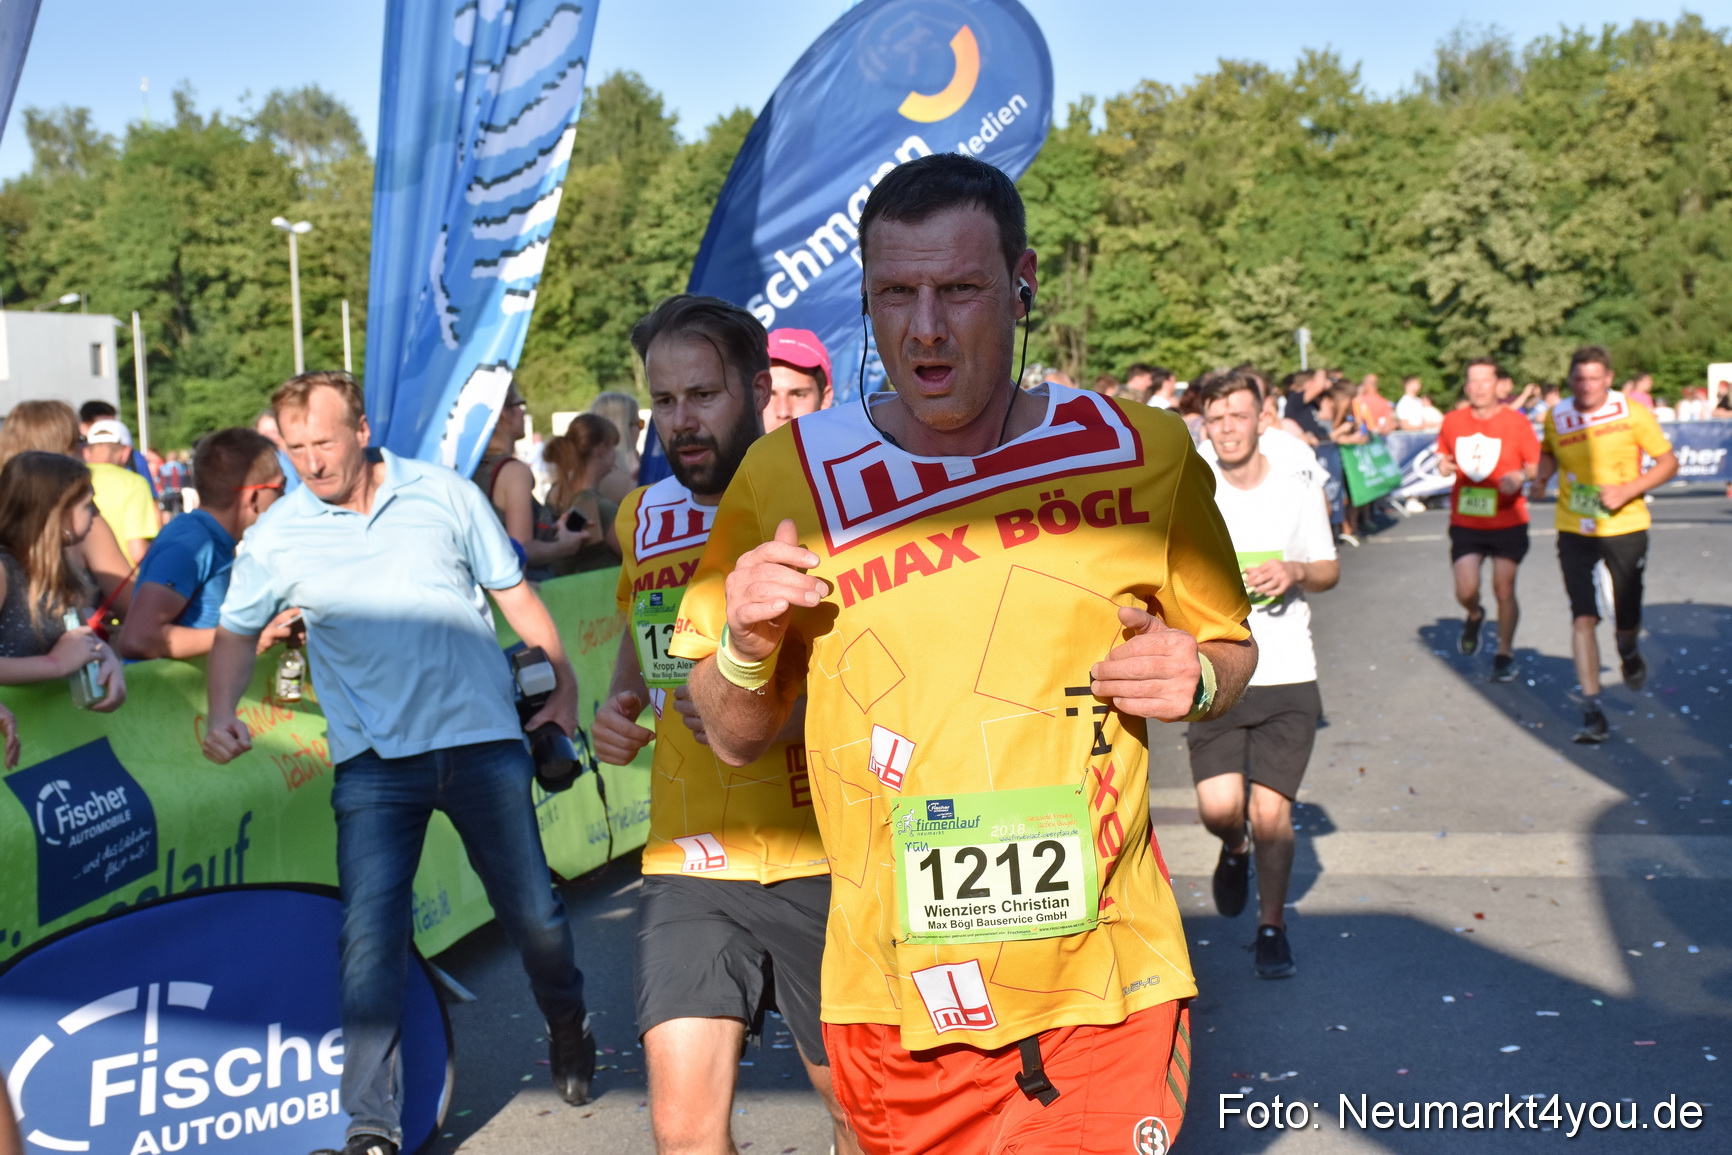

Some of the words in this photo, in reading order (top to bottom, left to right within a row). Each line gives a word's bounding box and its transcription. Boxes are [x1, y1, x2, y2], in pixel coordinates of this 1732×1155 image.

[836, 523, 981, 609] MAX
[994, 487, 1150, 549] BÖGL
[633, 557, 701, 601] MAX
[653, 662, 675, 672] Kropp
[54, 786, 128, 835] Fischer
[916, 815, 981, 831] firmenlauf
[69, 809, 132, 848] AUTOMOBILE
[990, 823, 1026, 837] 2018
[920, 839, 1069, 901] 1212
[924, 903, 997, 918] Wienziers
[1001, 896, 1070, 913] Christian
[928, 920, 947, 930] Max
[950, 918, 974, 931] Bögl
[976, 914, 1033, 927] Bauservice
[1035, 910, 1068, 922] GmbH
